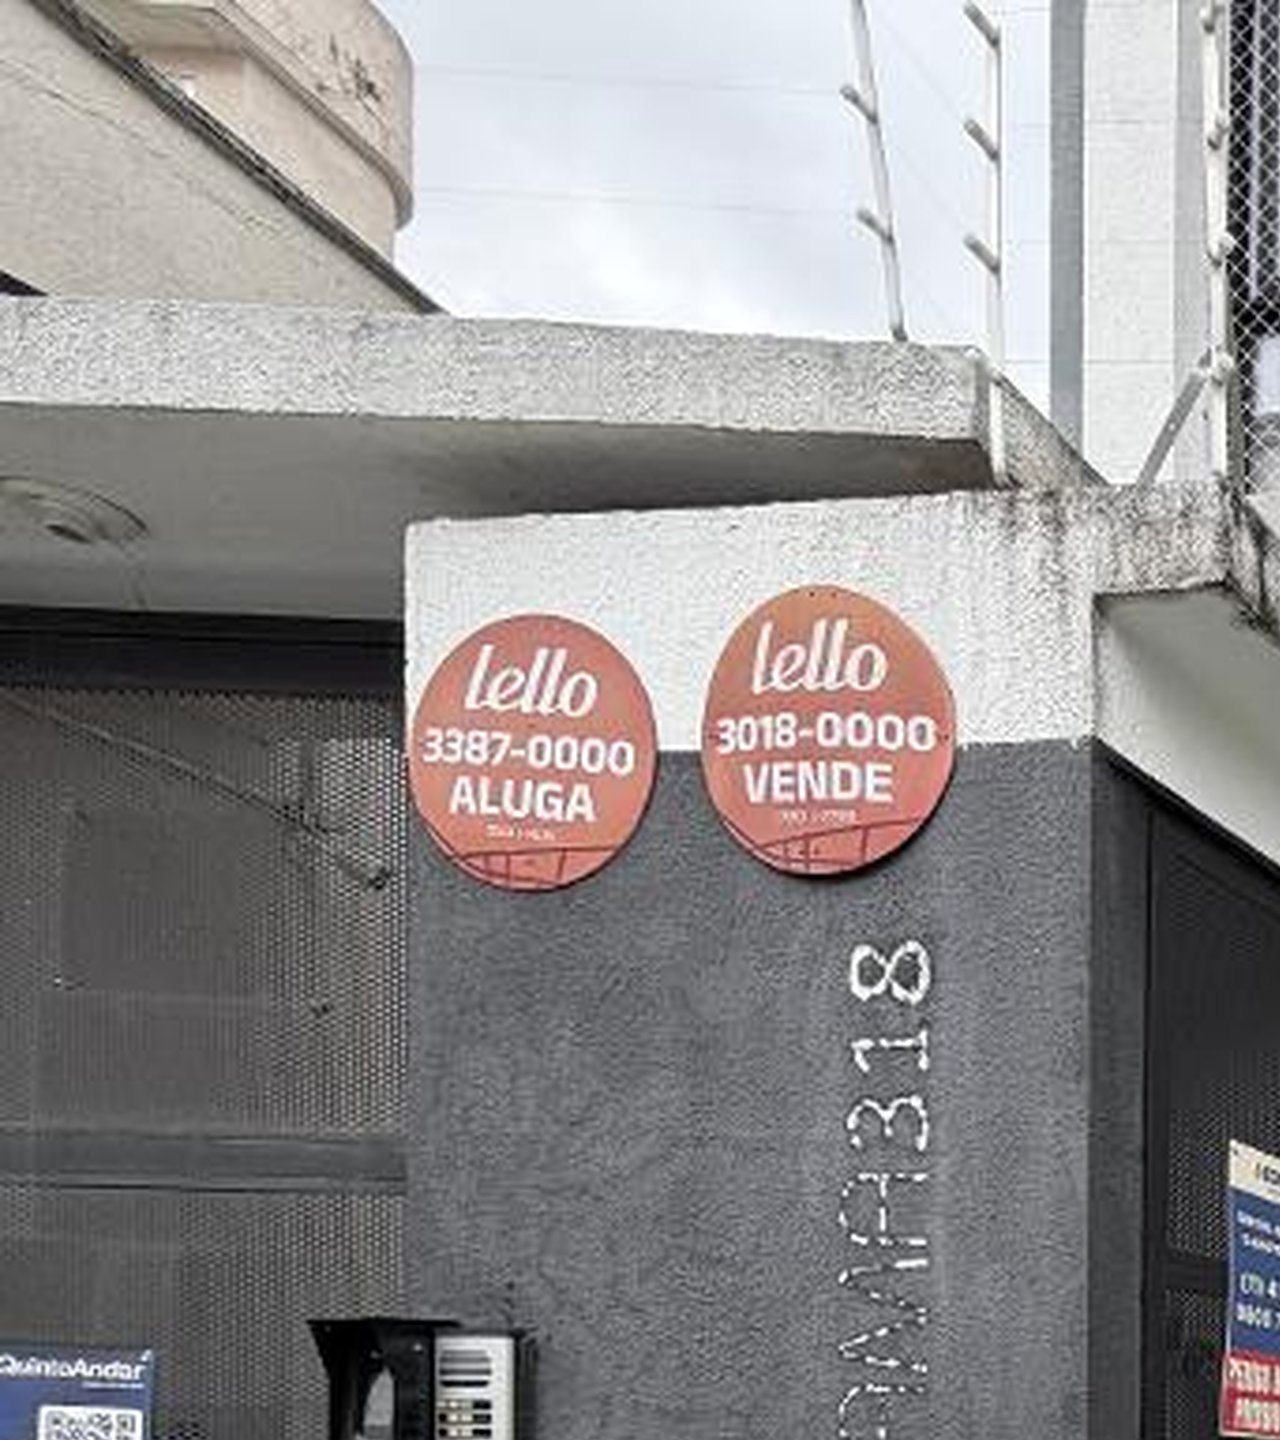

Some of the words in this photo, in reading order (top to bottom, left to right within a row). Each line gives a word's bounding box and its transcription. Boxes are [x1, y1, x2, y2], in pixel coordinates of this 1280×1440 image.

[464, 643, 599, 718] lello
[752, 617, 889, 697] lello
[422, 727, 636, 777] 3387-0000
[716, 711, 938, 755] 3018-0000
[450, 774, 597, 823] ALUGA
[744, 760, 894, 805] VENDE
[847, 940, 931, 1152] 318
[0, 1352, 146, 1380] QuintoAndar
